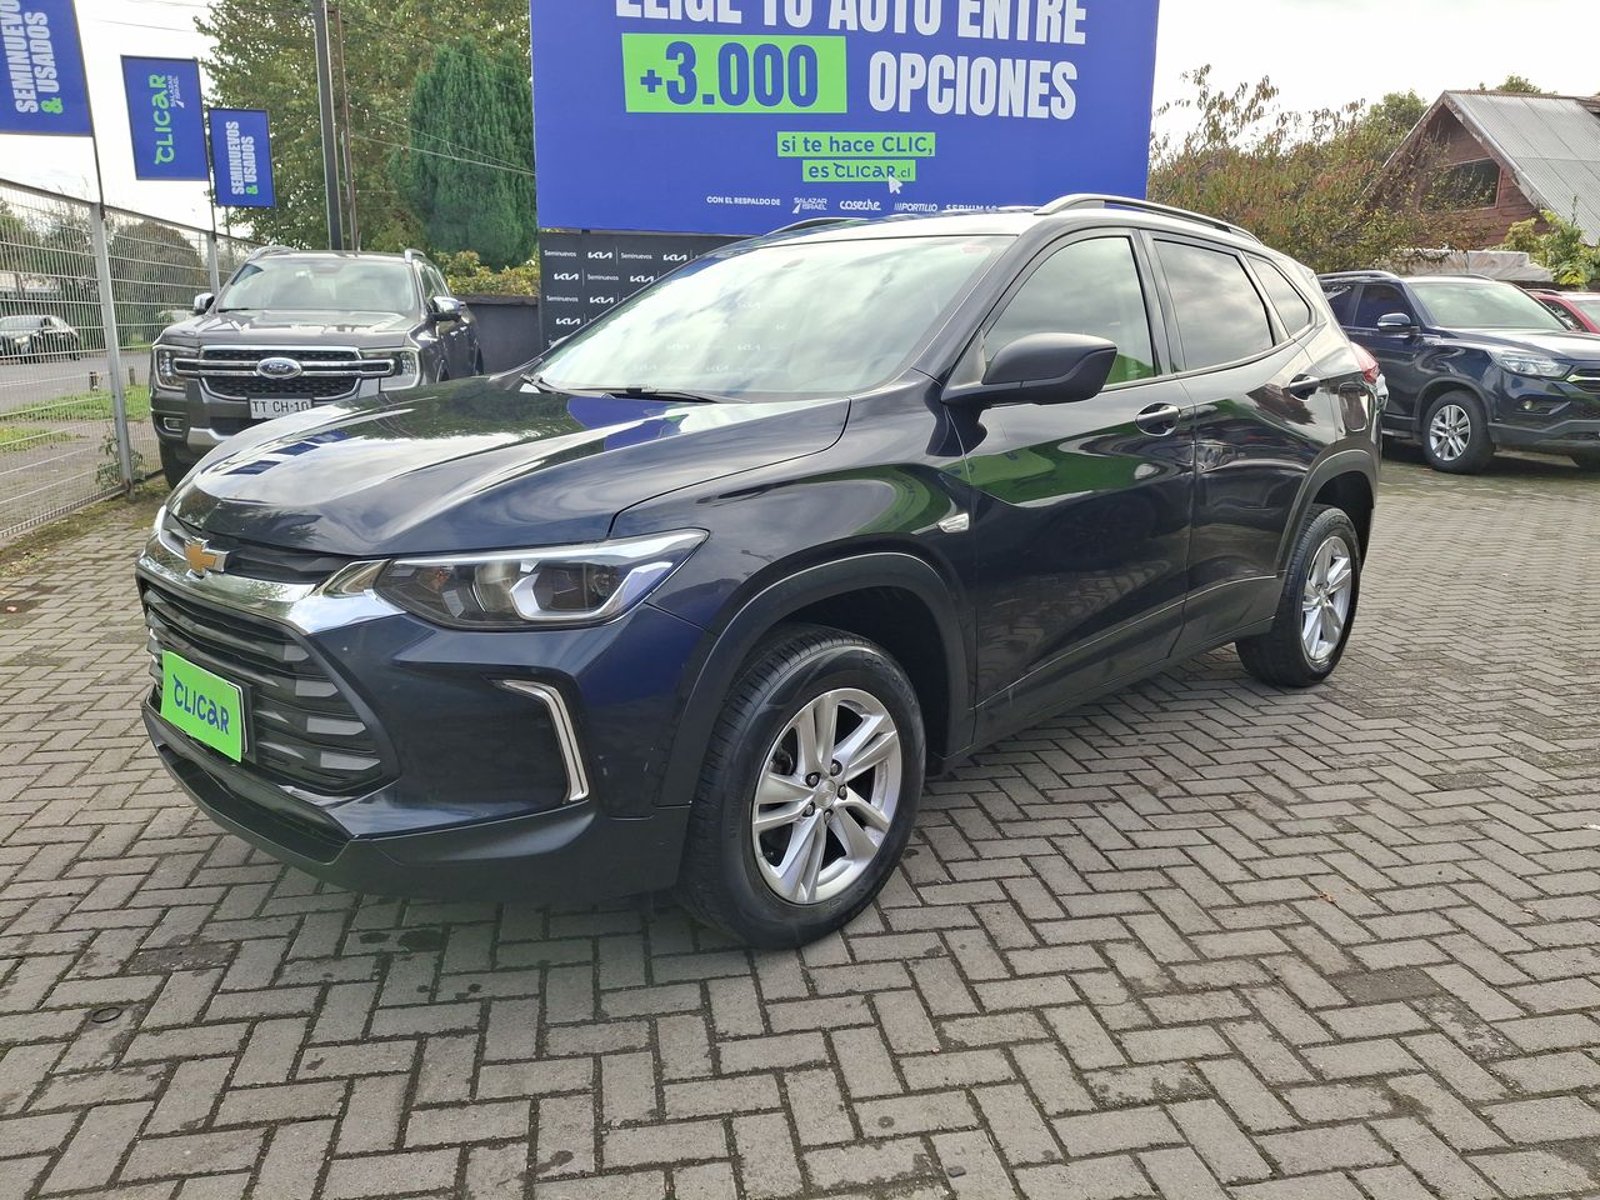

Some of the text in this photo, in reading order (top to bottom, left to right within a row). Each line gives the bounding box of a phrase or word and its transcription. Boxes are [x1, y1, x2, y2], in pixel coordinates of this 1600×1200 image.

[0, 0, 39, 113] SEMINUEVO
[24, 12, 63, 115] & USADOS
[640, 41, 1078, 120] +3.000 OPCIONES
[226, 121, 245, 194] SEMINUEVOS
[240, 136, 257, 183] USADOS
[781, 136, 933, 155] si te hace CLIC,
[808, 165, 830, 178] es
[706, 196, 723, 204] CON
[734, 197, 771, 206] RESPALDO
[771, 198, 780, 206] DE
[544, 250, 577, 258] Seminuevos
[620, 252, 653, 260] Seminuevos
[546, 295, 579, 303] Seminuevos
